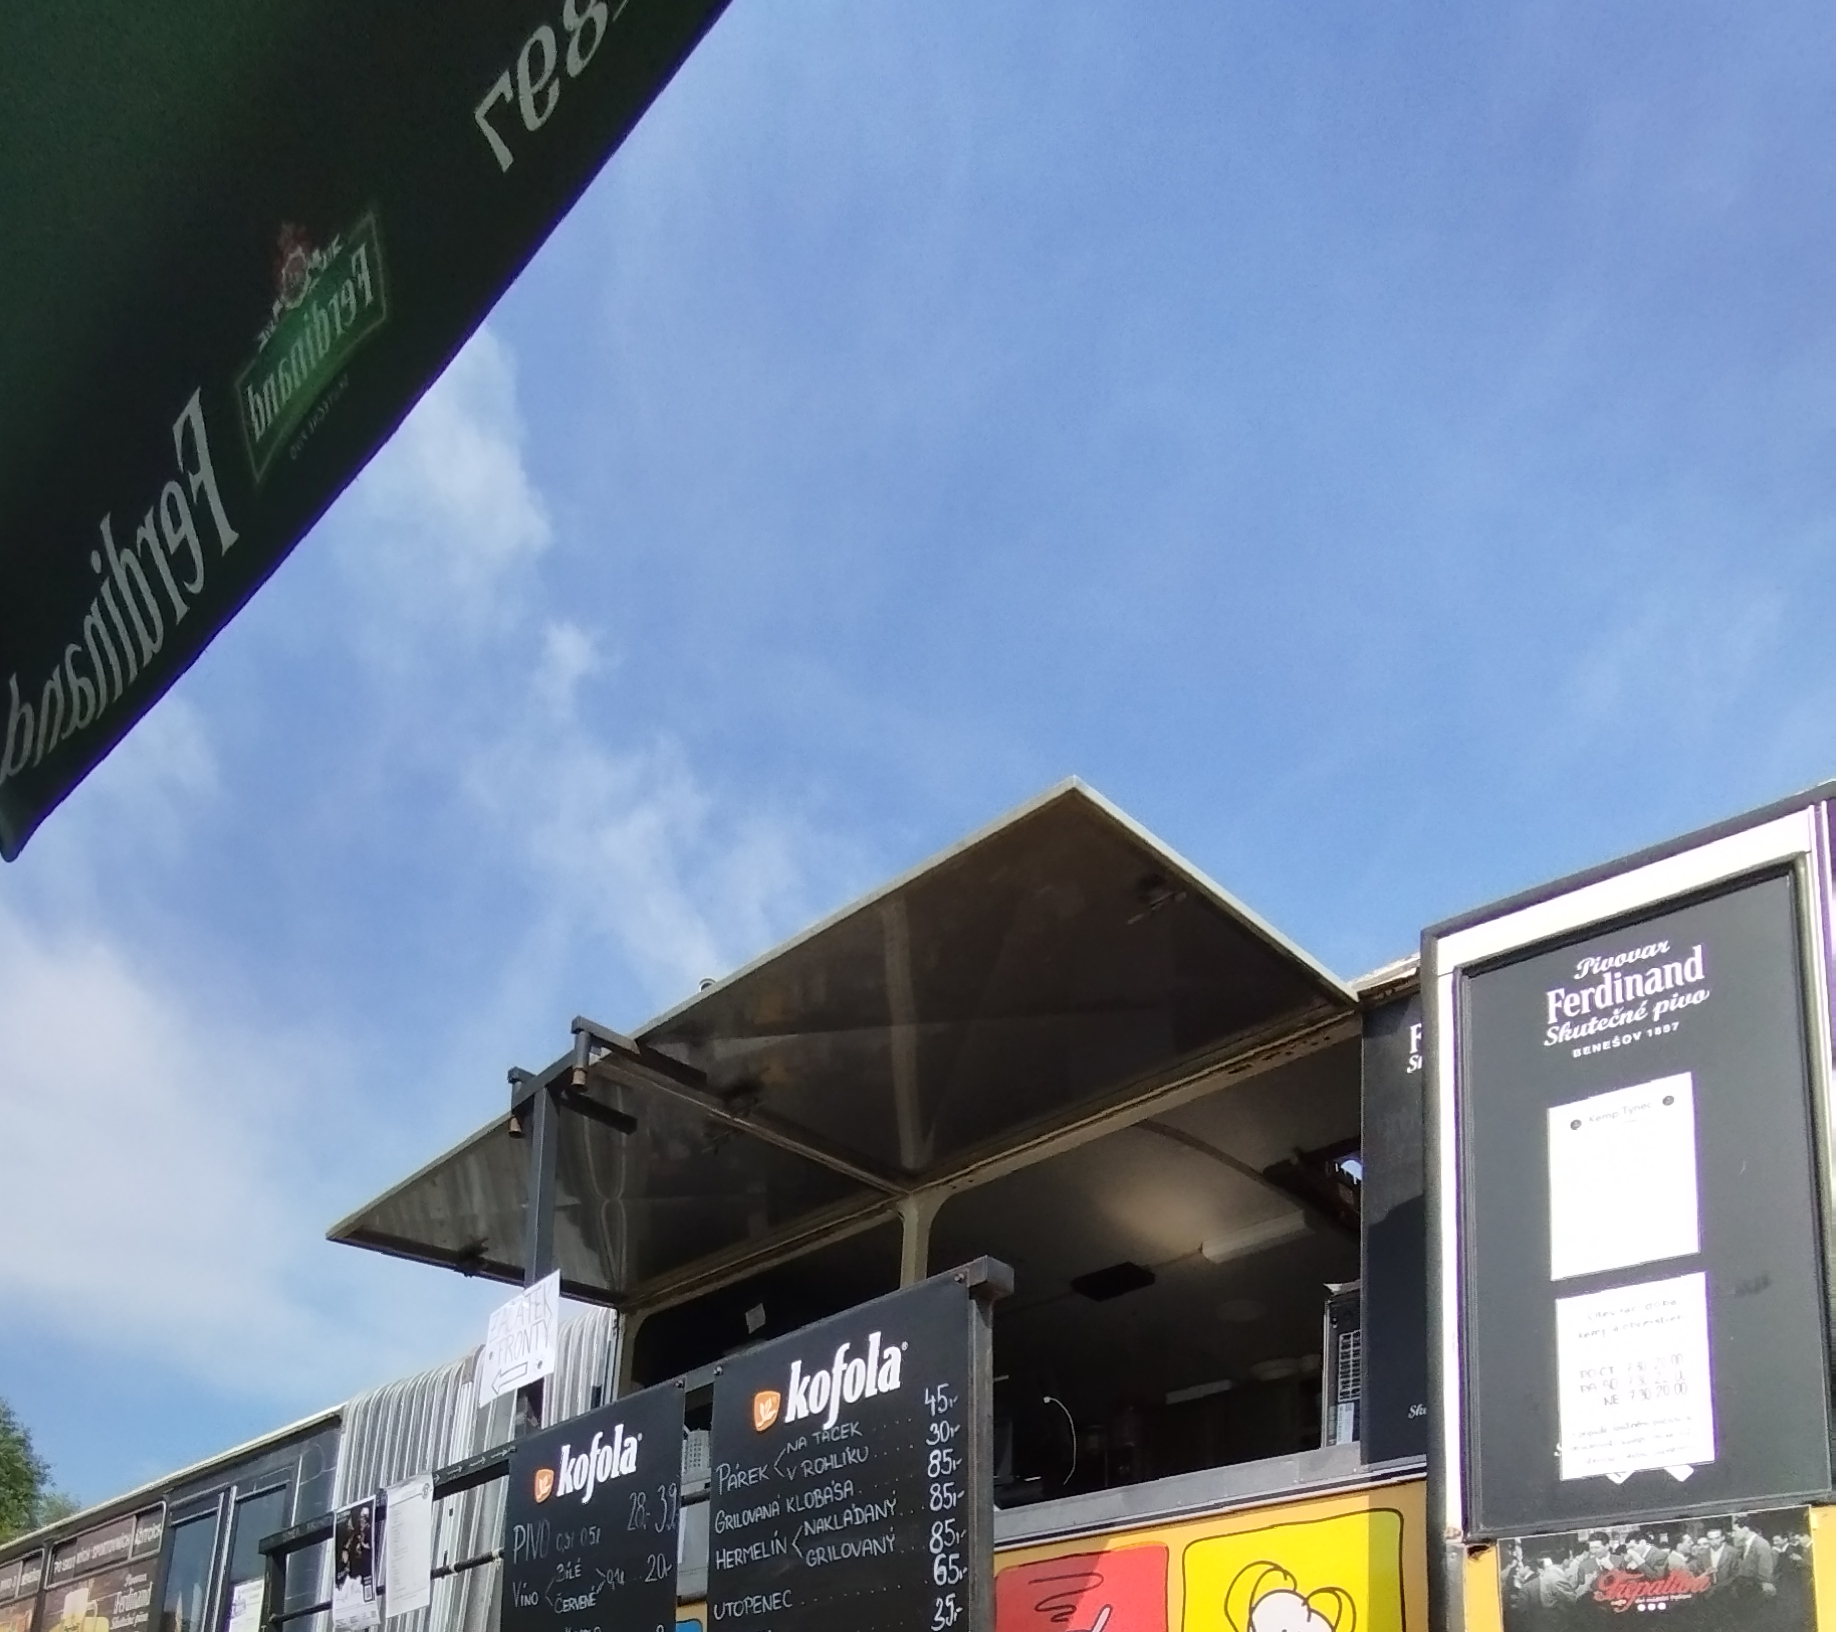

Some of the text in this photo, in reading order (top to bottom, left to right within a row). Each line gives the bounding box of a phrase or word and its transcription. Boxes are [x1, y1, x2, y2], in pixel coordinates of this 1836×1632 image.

[1574, 940, 1670, 980] Pivovar
[1546, 944, 1705, 1024] Ferdinand
[1543, 989, 1711, 1046] Skutečné pivo
[1572, 1031, 1642, 1058] BENEŠOV
[785, 1331, 902, 1429] kofola
[557, 1423, 638, 1504] kofola
[716, 1462, 770, 1495] PÁREK
[787, 1437, 807, 1454] NA
[787, 1466, 797, 1480] V
[715, 1494, 780, 1533] GRILOVANÁ
[716, 1531, 787, 1570] HERMELÍN
[803, 1489, 897, 1536] NAKLÁDANÝ
[513, 1519, 550, 1562] PIVO
[806, 1526, 896, 1567] GRILOVANÝ
[554, 1586, 597, 1614] ČERVENÉ
[713, 1589, 793, 1620] UTOPENEC
